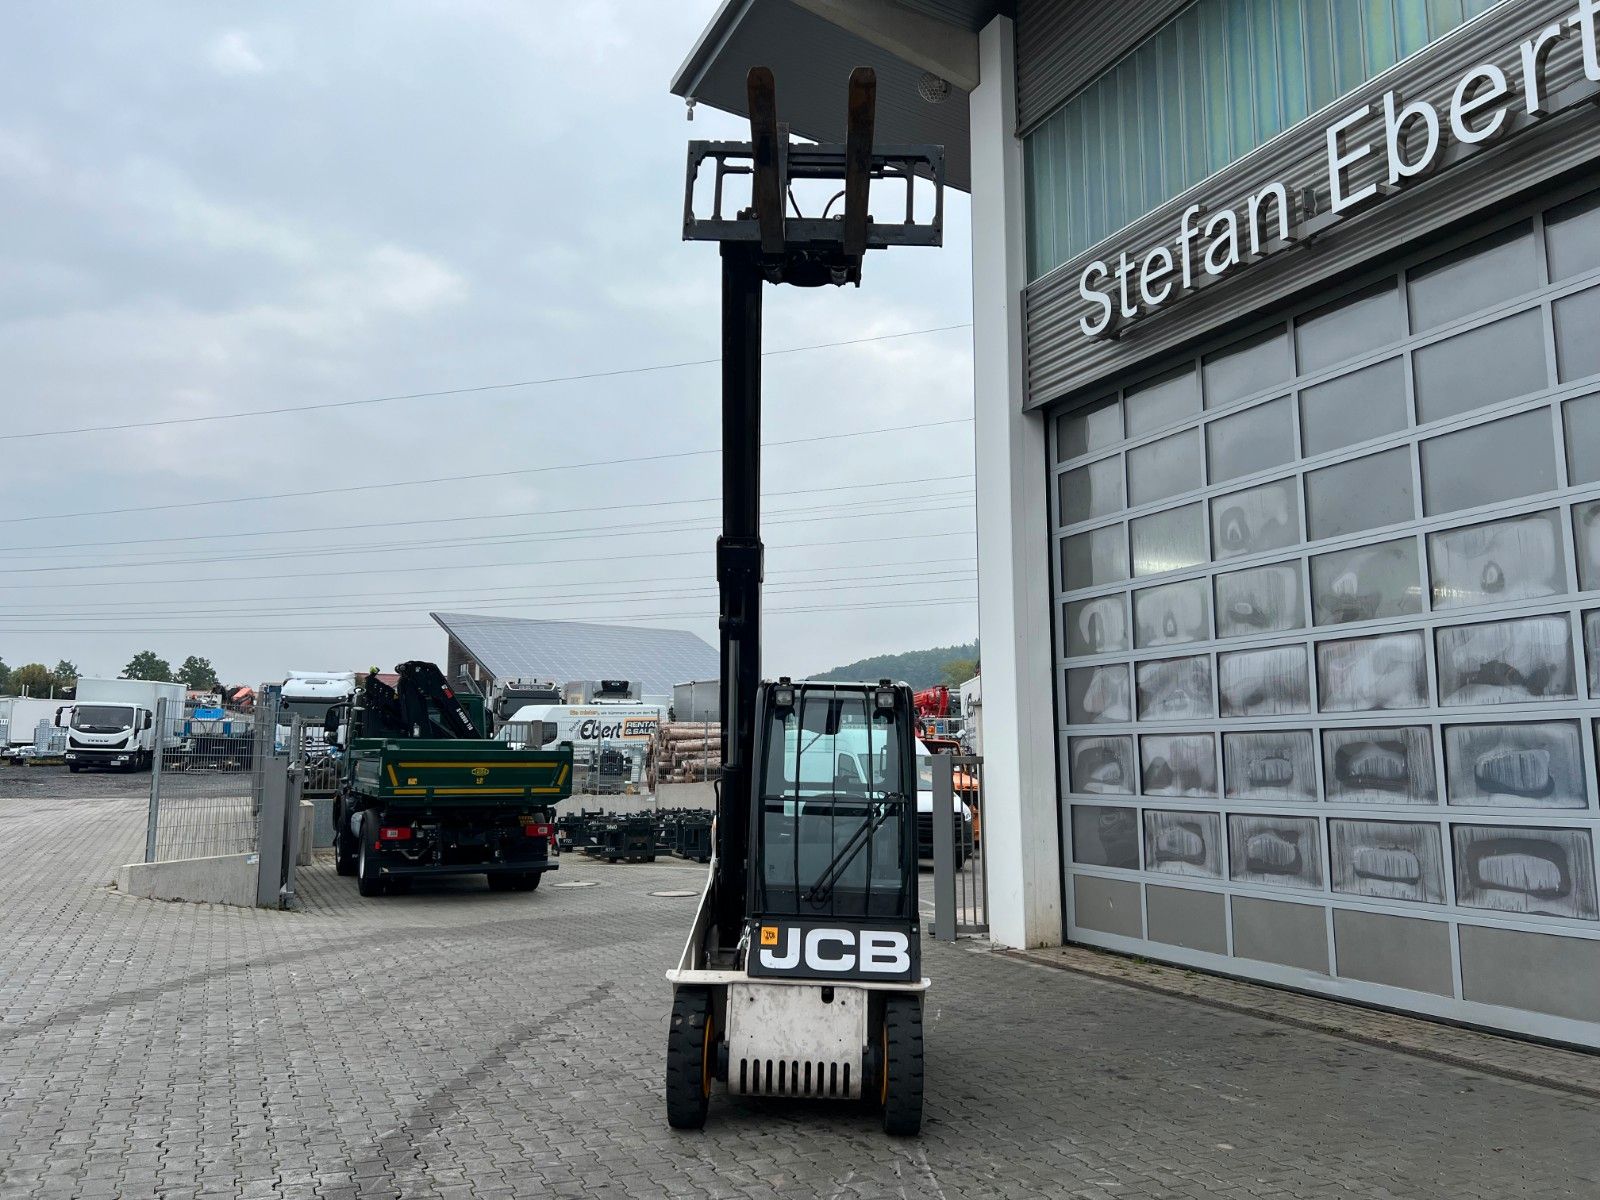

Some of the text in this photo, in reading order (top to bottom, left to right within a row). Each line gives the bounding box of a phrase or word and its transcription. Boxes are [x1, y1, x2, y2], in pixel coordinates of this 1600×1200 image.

[1079, 0, 1600, 338] Stefan Ebert
[580, 719, 622, 740] Ebert
[760, 928, 911, 974] JCB
